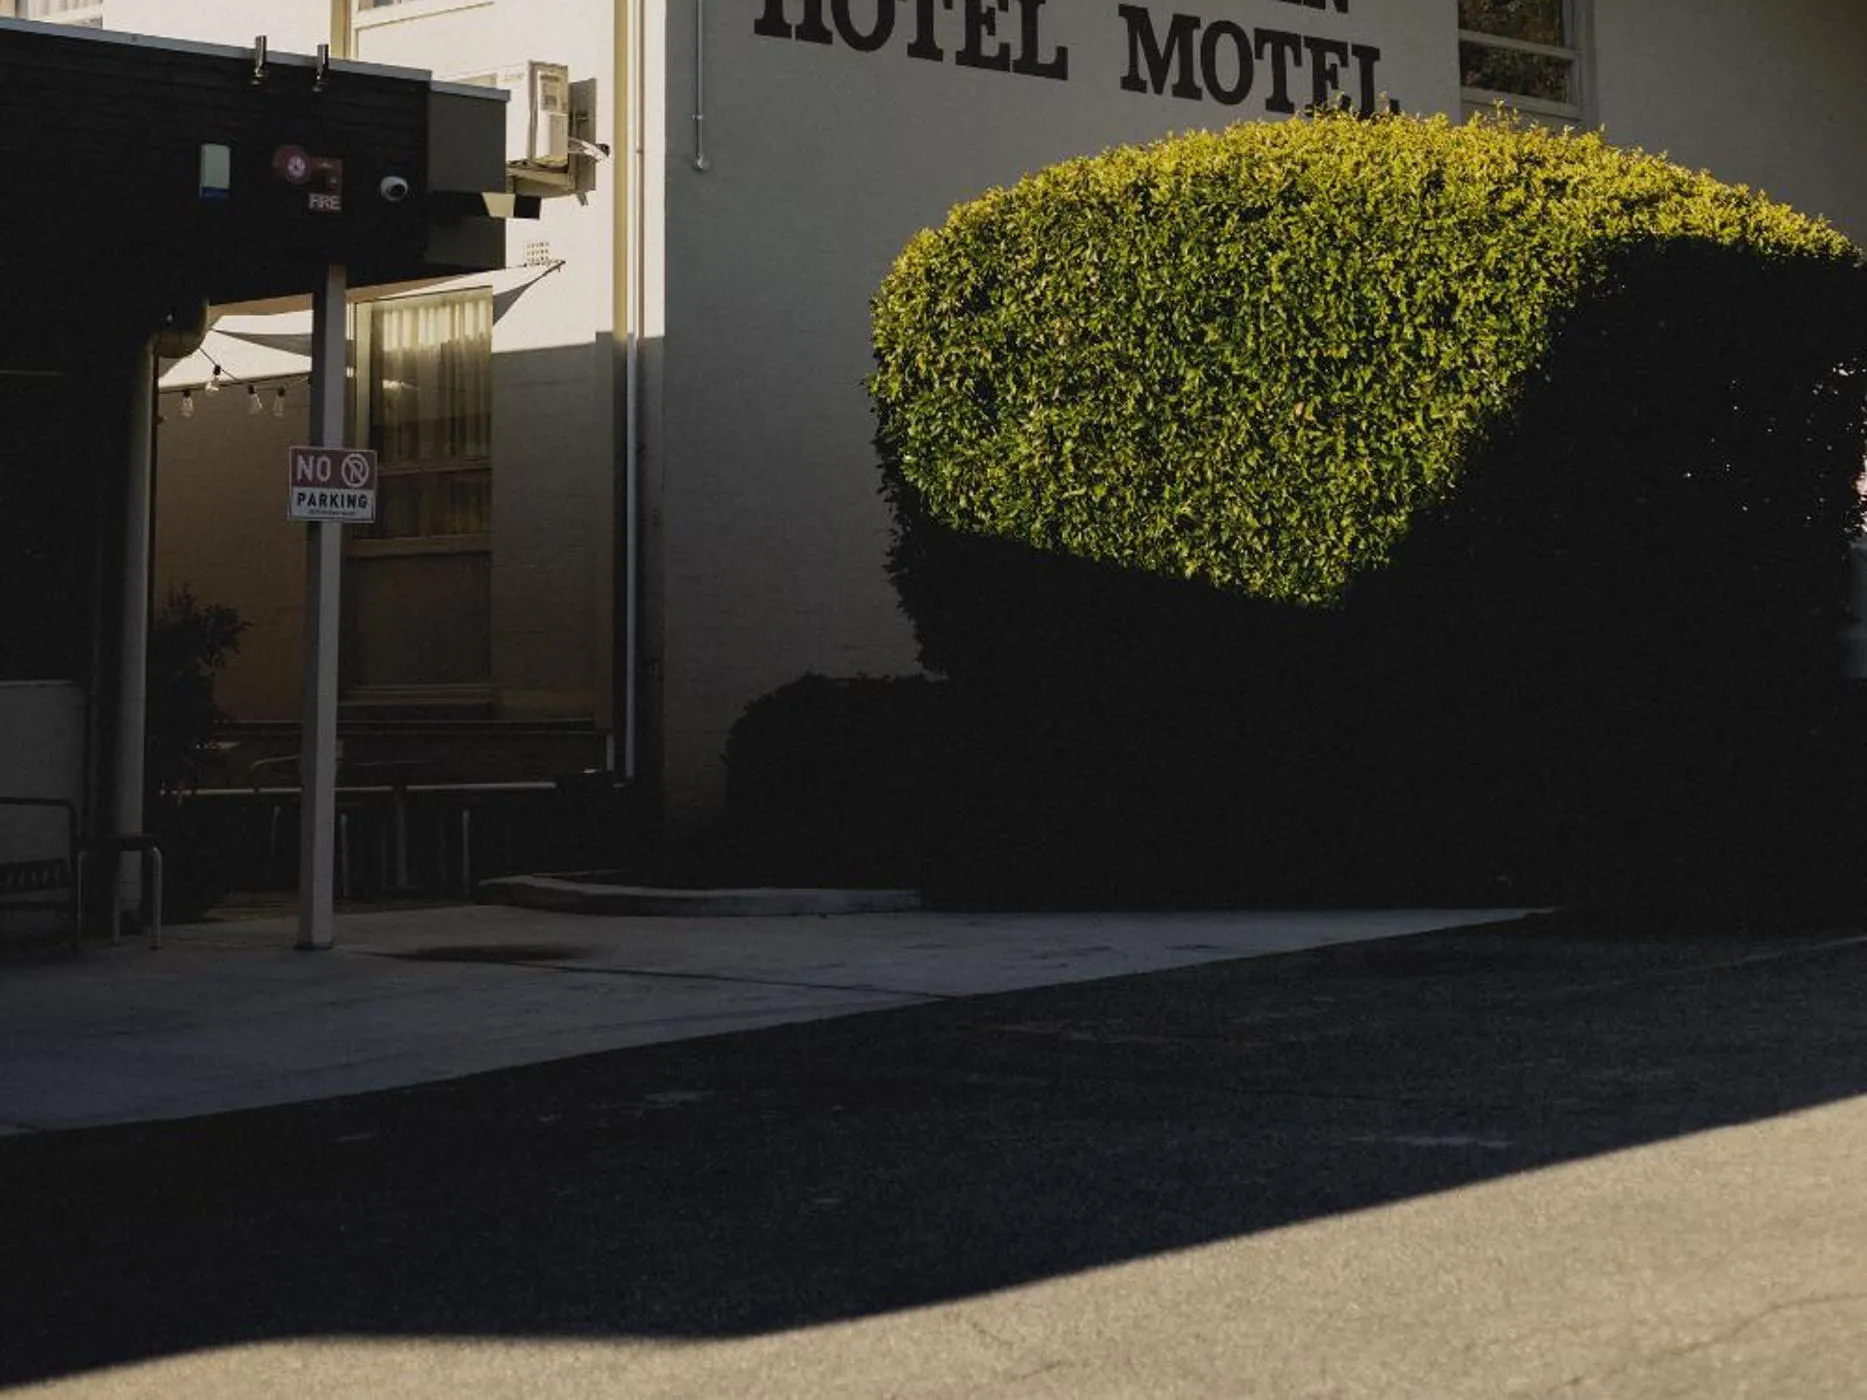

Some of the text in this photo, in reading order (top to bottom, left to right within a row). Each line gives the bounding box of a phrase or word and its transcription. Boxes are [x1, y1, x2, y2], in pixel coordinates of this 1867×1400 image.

[1117, 3, 1400, 119] MOTEL
[308, 193, 341, 211] FIRE
[296, 455, 332, 482] NO
[297, 492, 368, 509] PARKING
